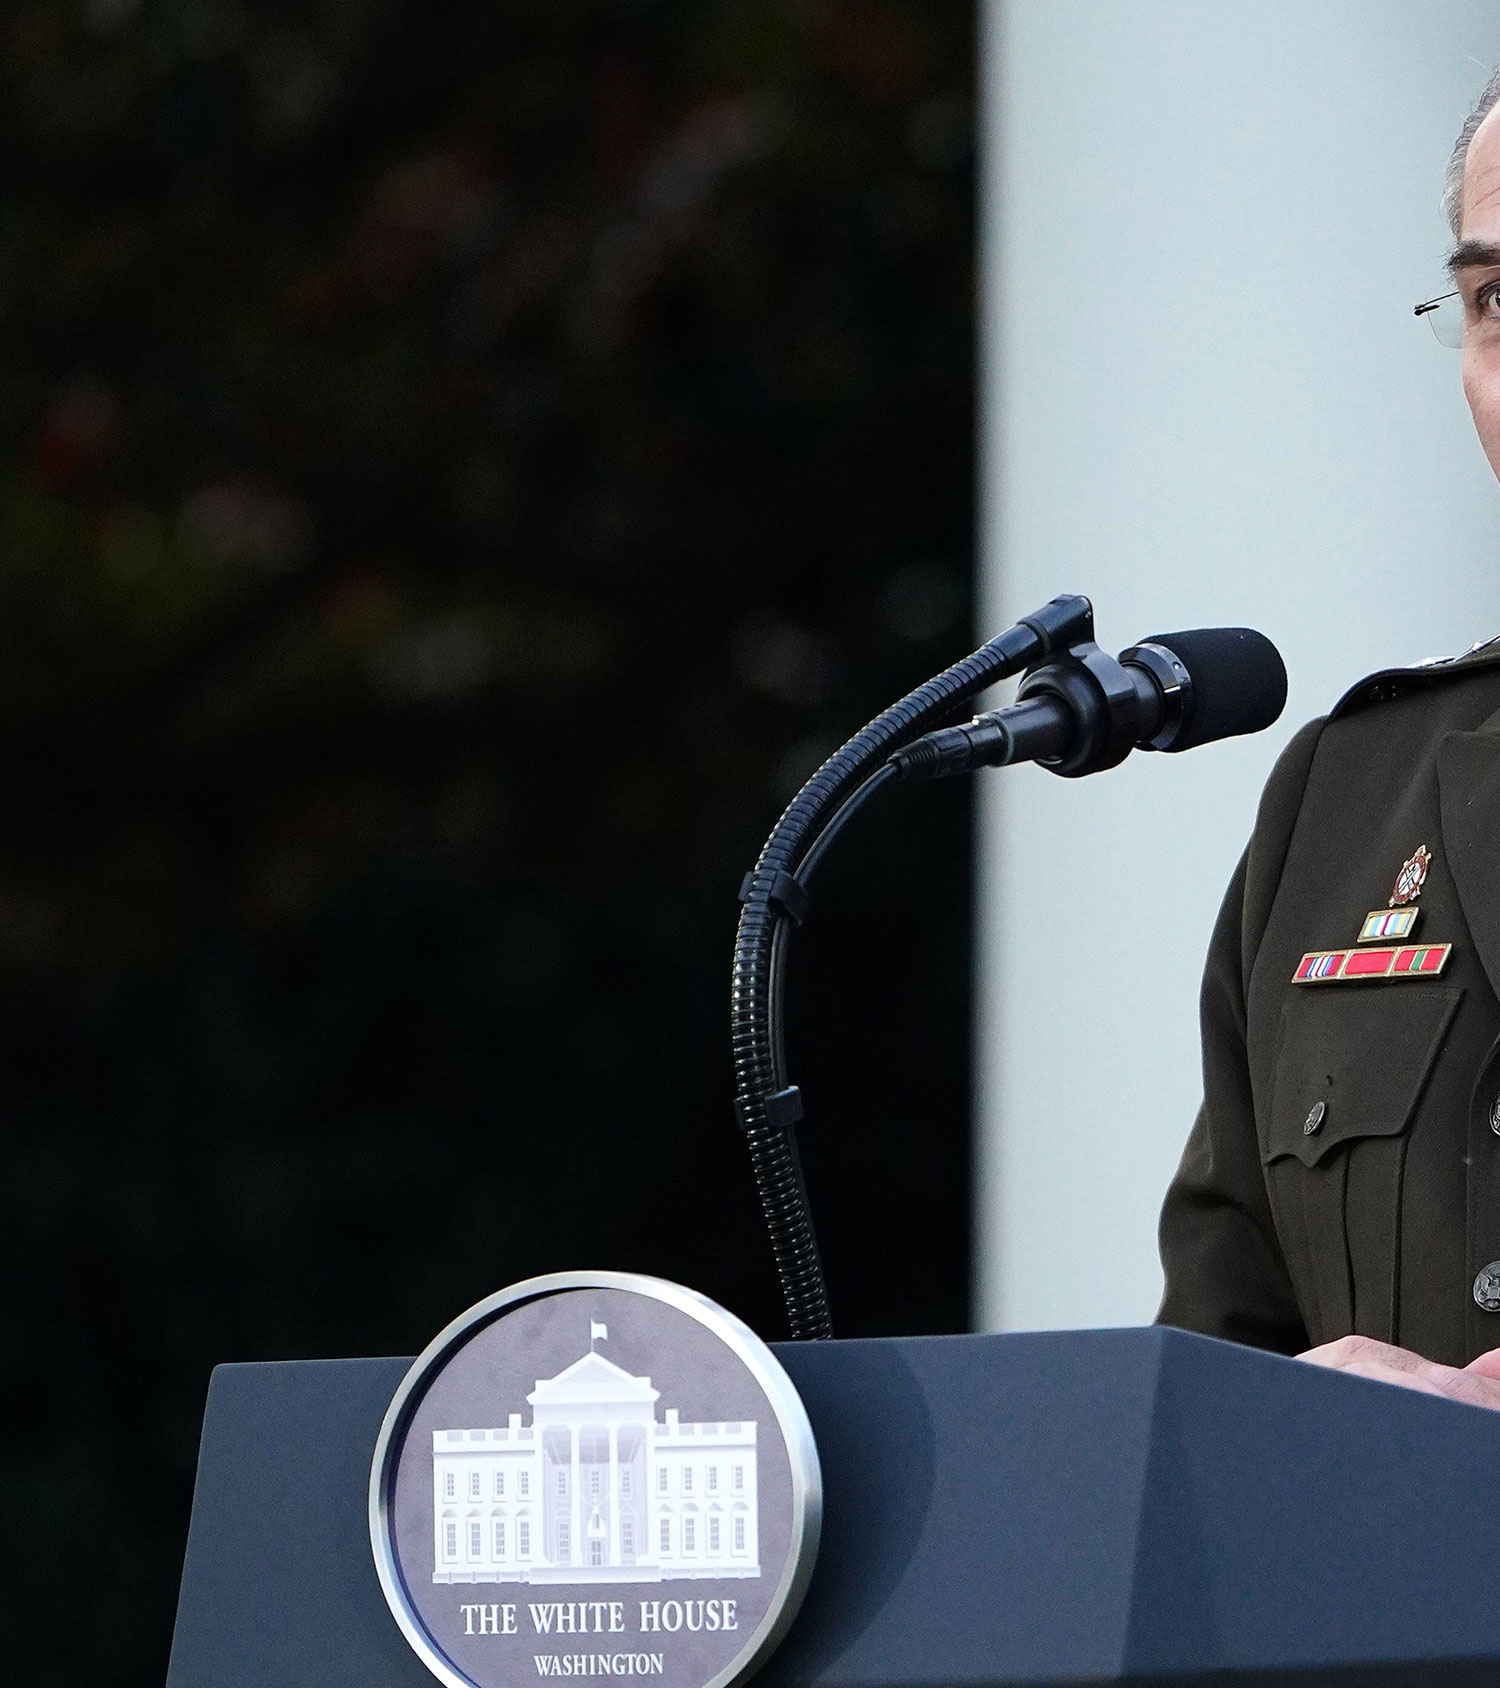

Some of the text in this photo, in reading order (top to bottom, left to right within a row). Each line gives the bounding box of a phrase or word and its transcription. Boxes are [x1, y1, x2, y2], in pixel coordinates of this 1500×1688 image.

[460, 1599, 739, 1636] THE WHITE HOUSE
[533, 1652, 664, 1677] WASHINGTON
